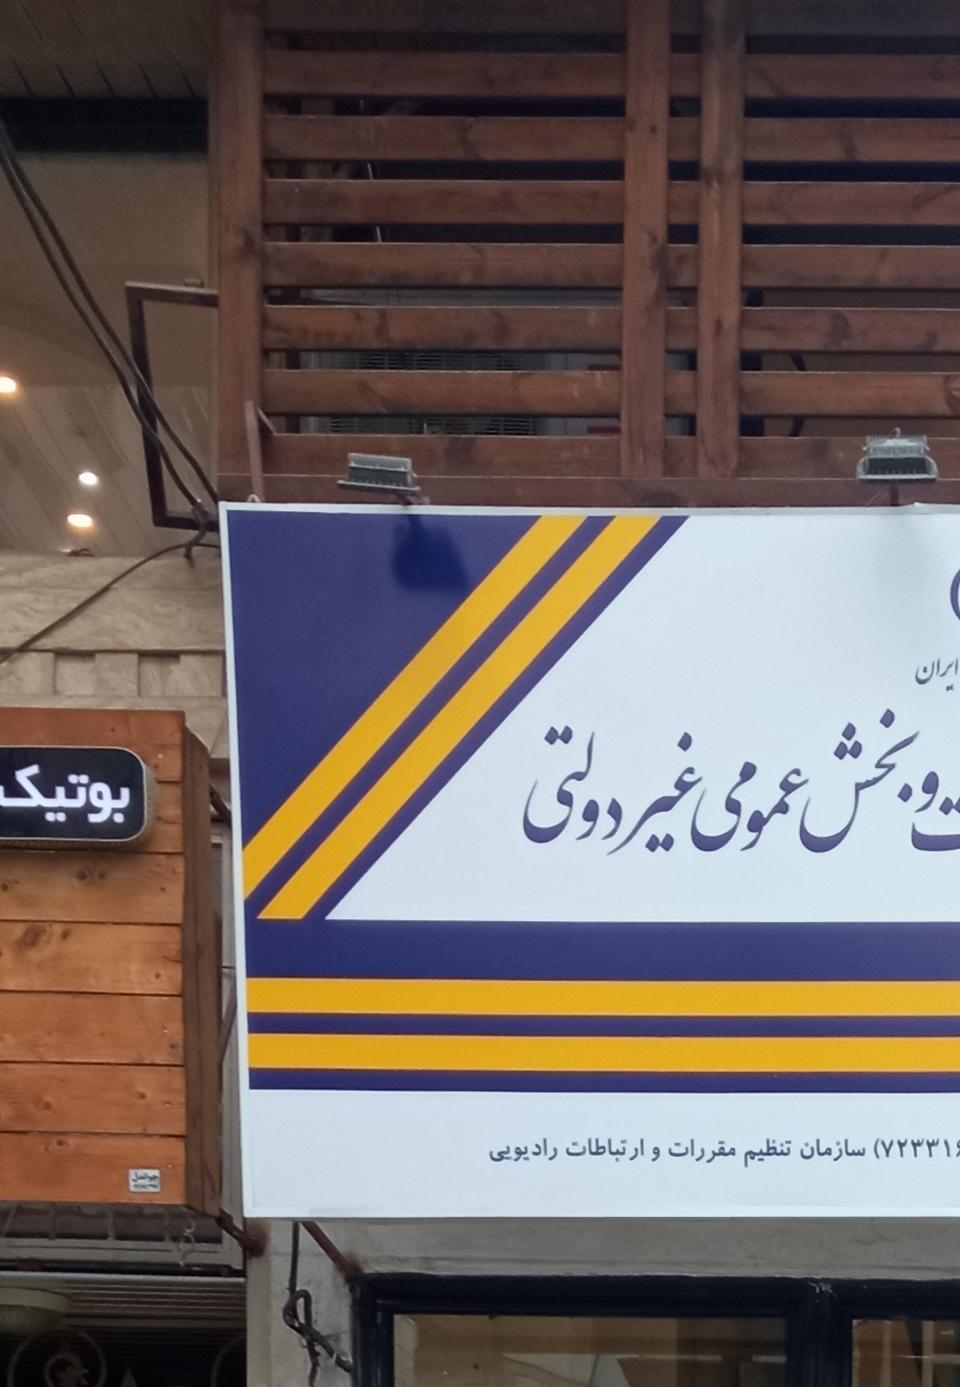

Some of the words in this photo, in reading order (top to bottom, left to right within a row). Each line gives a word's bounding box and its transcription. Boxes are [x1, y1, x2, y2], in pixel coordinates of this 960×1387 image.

[915, 658, 959, 691] ایران
[800, 708, 919, 854] بخش
[690, 761, 809, 852] عمومی
[489, 1138, 558, 1163] رادیویی
[565, 1138, 645, 1162] ارتباطات
[651, 1146, 661, 1162] و
[668, 1140, 736, 1164] مقررات
[743, 1138, 791, 1168] تنظیم
[799, 1138, 866, 1161] سازمان
